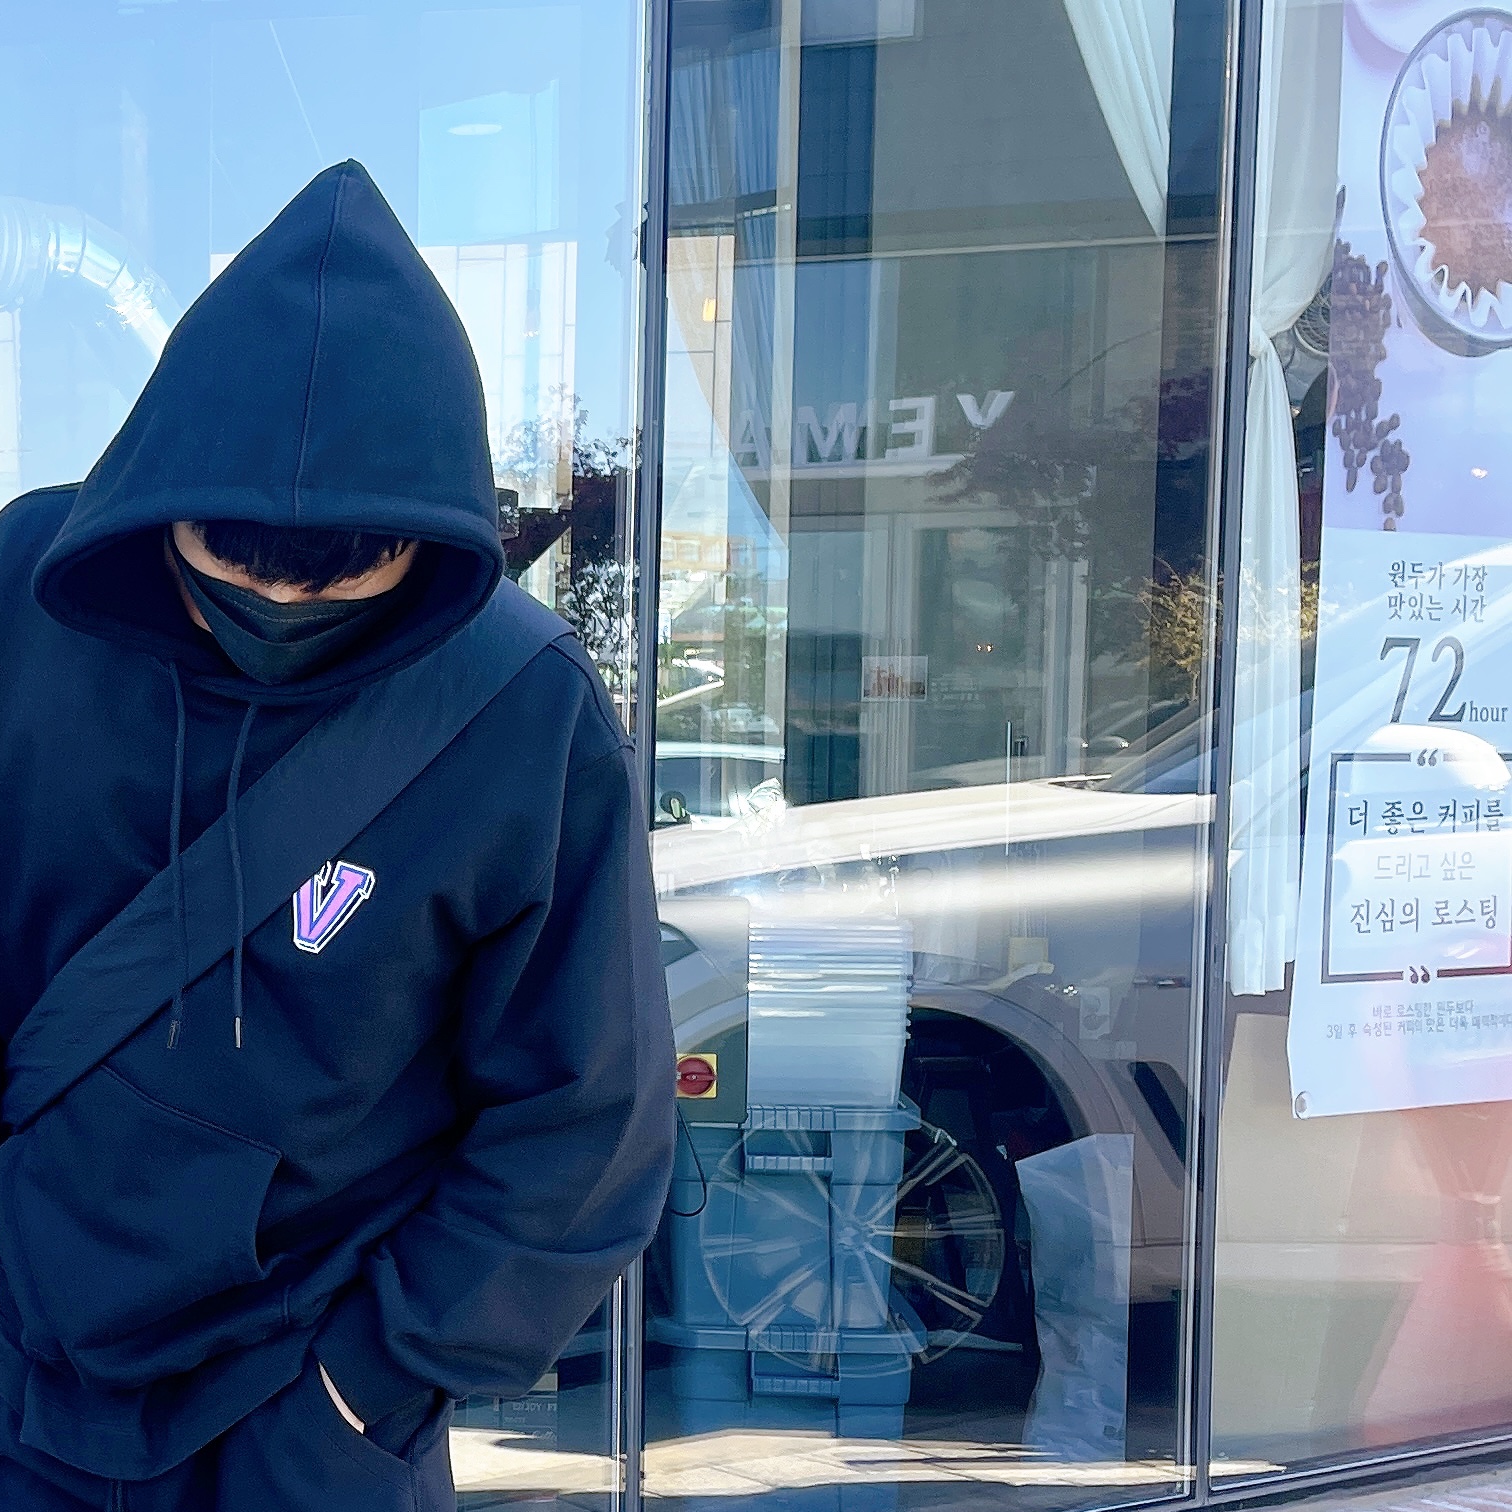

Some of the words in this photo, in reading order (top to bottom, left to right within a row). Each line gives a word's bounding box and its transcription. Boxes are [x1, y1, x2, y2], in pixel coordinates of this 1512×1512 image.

[1387, 559, 1446, 591] 원두가
[1452, 563, 1488, 593] 가장
[1387, 592, 1445, 622] 맛있는
[1451, 595, 1488, 623] 시간
[1347, 799, 1369, 837] 더
[1381, 800, 1428, 835] 좋은
[1437, 798, 1504, 833] 커피를
[1374, 852, 1431, 883] 드리고
[1440, 851, 1476, 881] 싶은
[1350, 896, 1420, 934] 진심의
[1431, 894, 1498, 930] 로스팅
